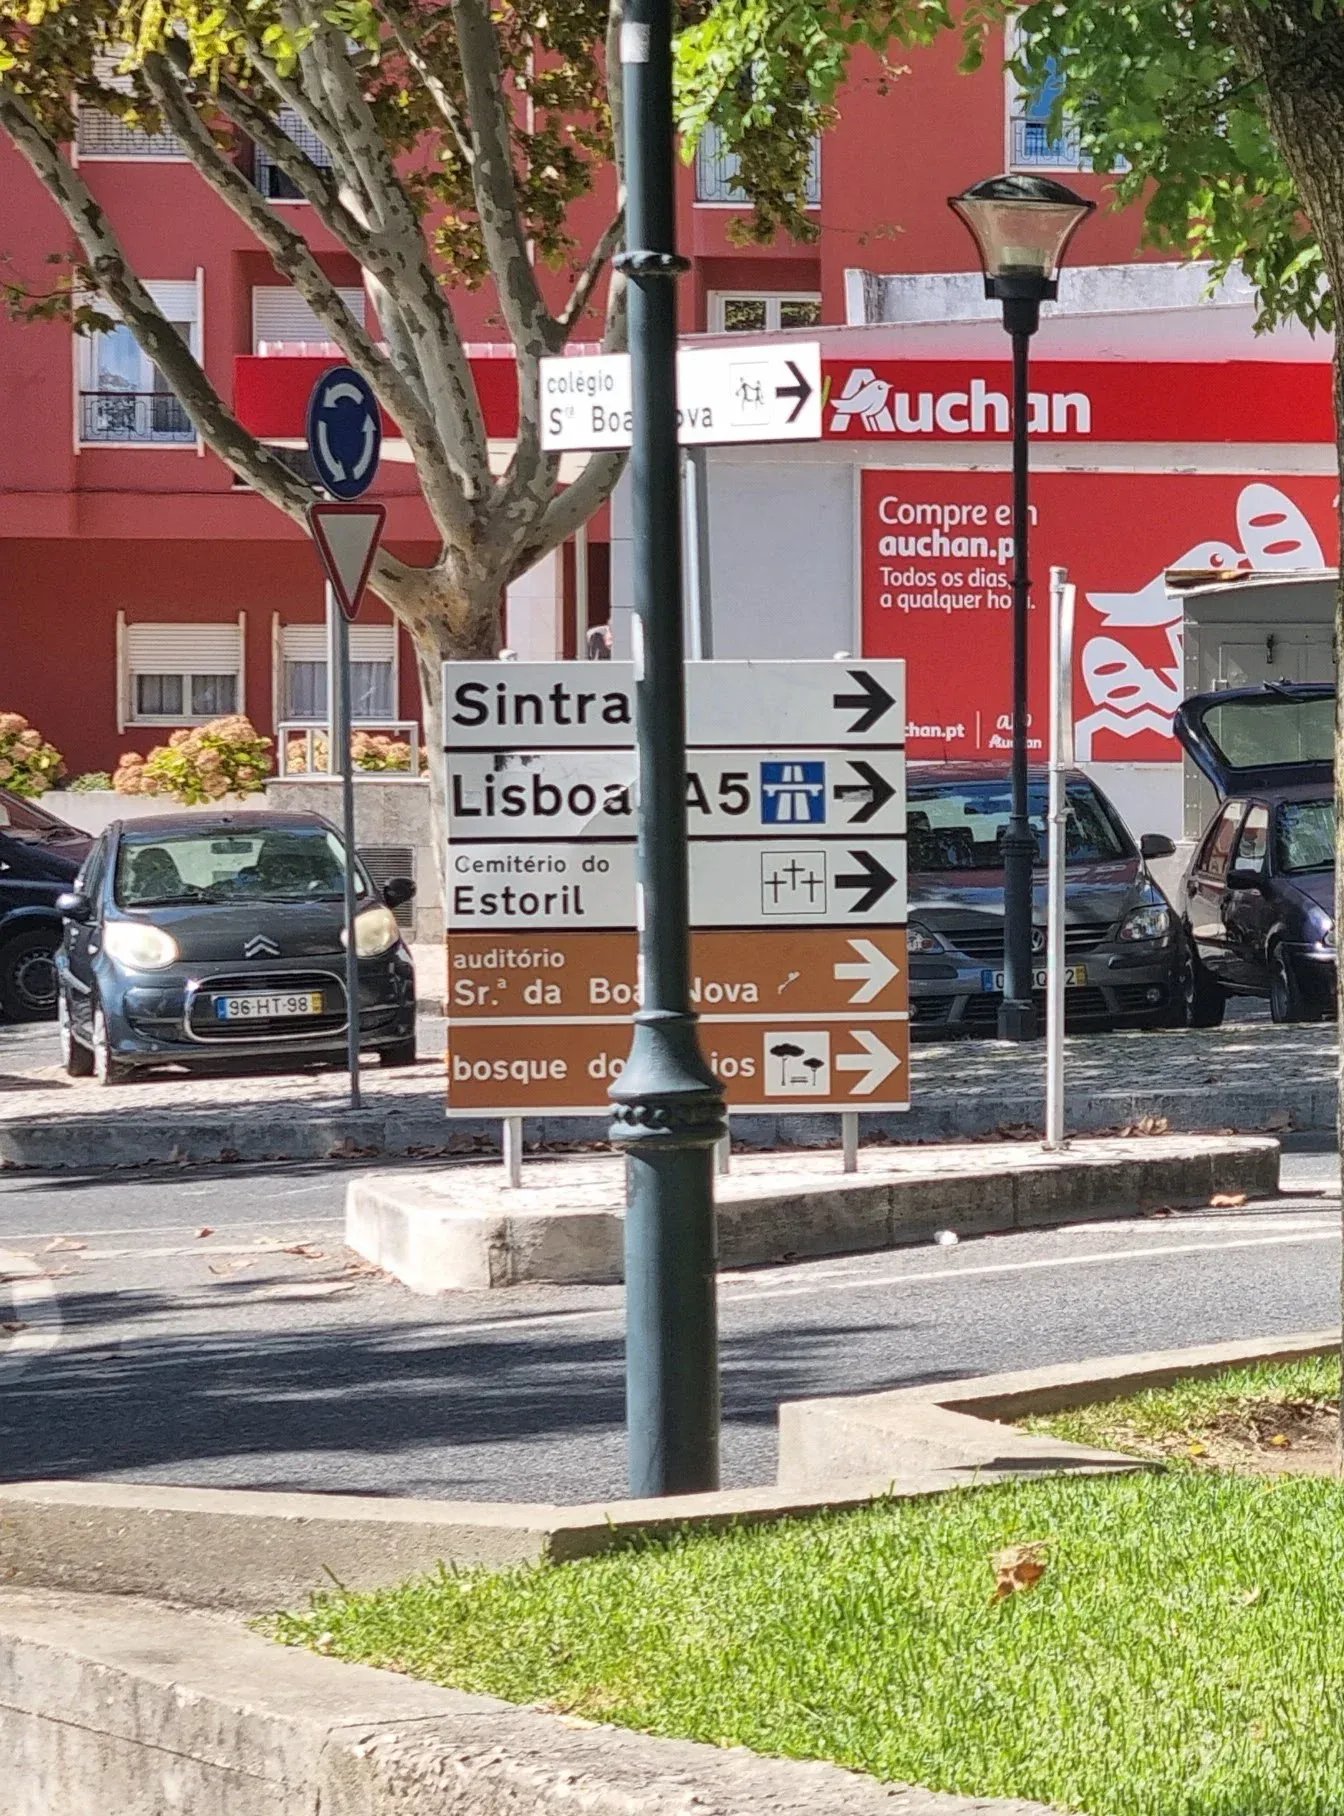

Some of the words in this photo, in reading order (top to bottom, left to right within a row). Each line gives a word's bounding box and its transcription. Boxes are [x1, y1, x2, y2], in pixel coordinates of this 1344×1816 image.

[829, 368, 1092, 434] Auchan
[674, 407, 713, 429] ova
[879, 496, 988, 533] Compre
[879, 528, 1015, 566] auchan.p
[879, 566, 937, 587] Todos
[941, 571, 964, 587] os
[968, 567, 1013, 590] dias,
[880, 593, 892, 608] a
[897, 588, 983, 614] qualquer
[987, 589, 1037, 609] ho.
[451, 682, 632, 727] Sintra
[988, 734, 1042, 749] Auan
[453, 773, 633, 817] Lisboa
[685, 772, 751, 816] A5
[454, 855, 567, 874] Cemitério
[582, 855, 610, 873] do
[454, 885, 585, 915] Estoril
[454, 948, 566, 970] auditório
[523, 979, 562, 1006] da
[229, 997, 308, 1016] 96-HT-98
[453, 1054, 568, 1085] bosque
[588, 1052, 627, 1079] do
[711, 1050, 756, 1078] ios
